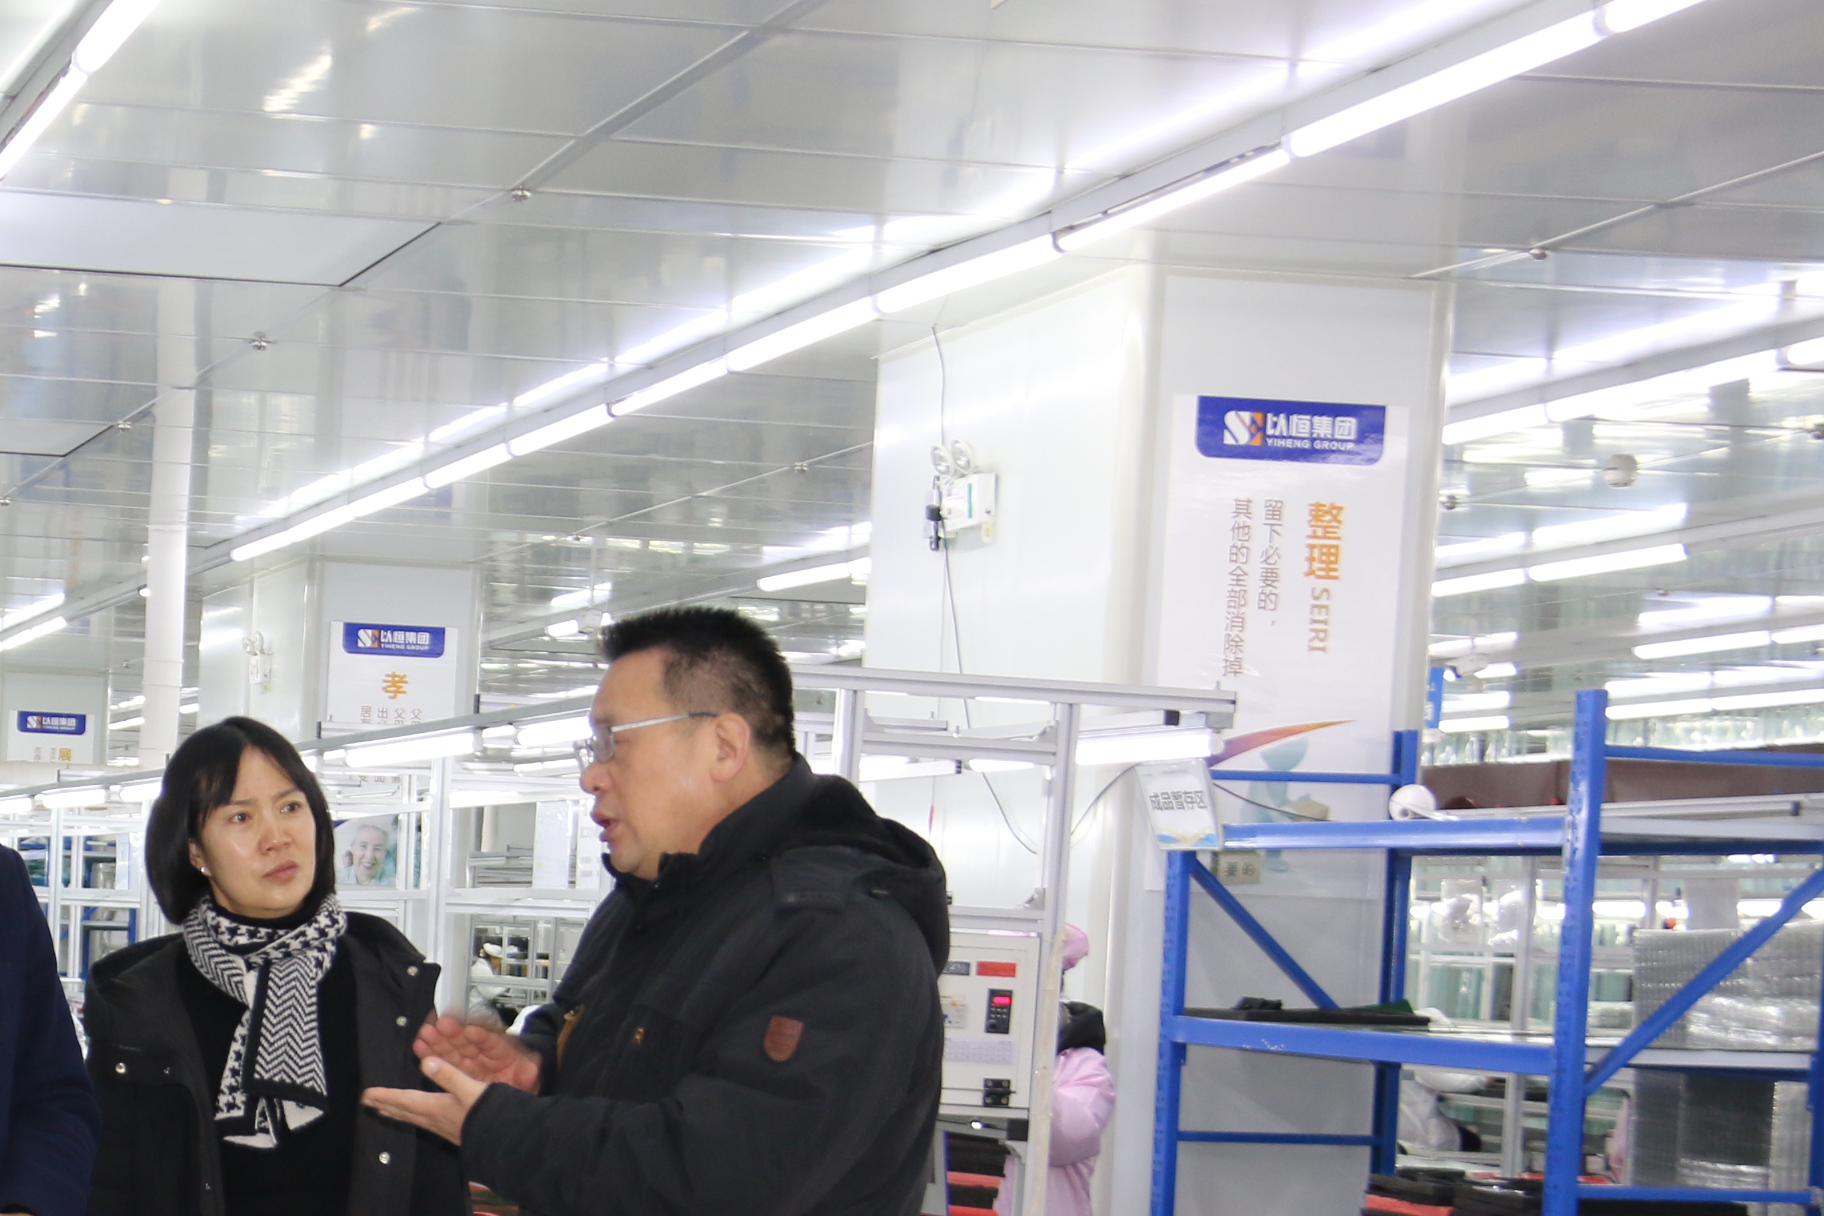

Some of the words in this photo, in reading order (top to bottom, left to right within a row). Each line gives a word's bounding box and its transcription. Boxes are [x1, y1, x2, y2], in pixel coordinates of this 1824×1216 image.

[1266, 412, 1358, 440] 以恒集团
[1266, 437, 1310, 449] YIHENG
[1313, 440, 1356, 450] GROUP
[1303, 501, 1344, 581] 整理
[1307, 586, 1331, 654] SEIRI
[381, 671, 409, 700] 孝
